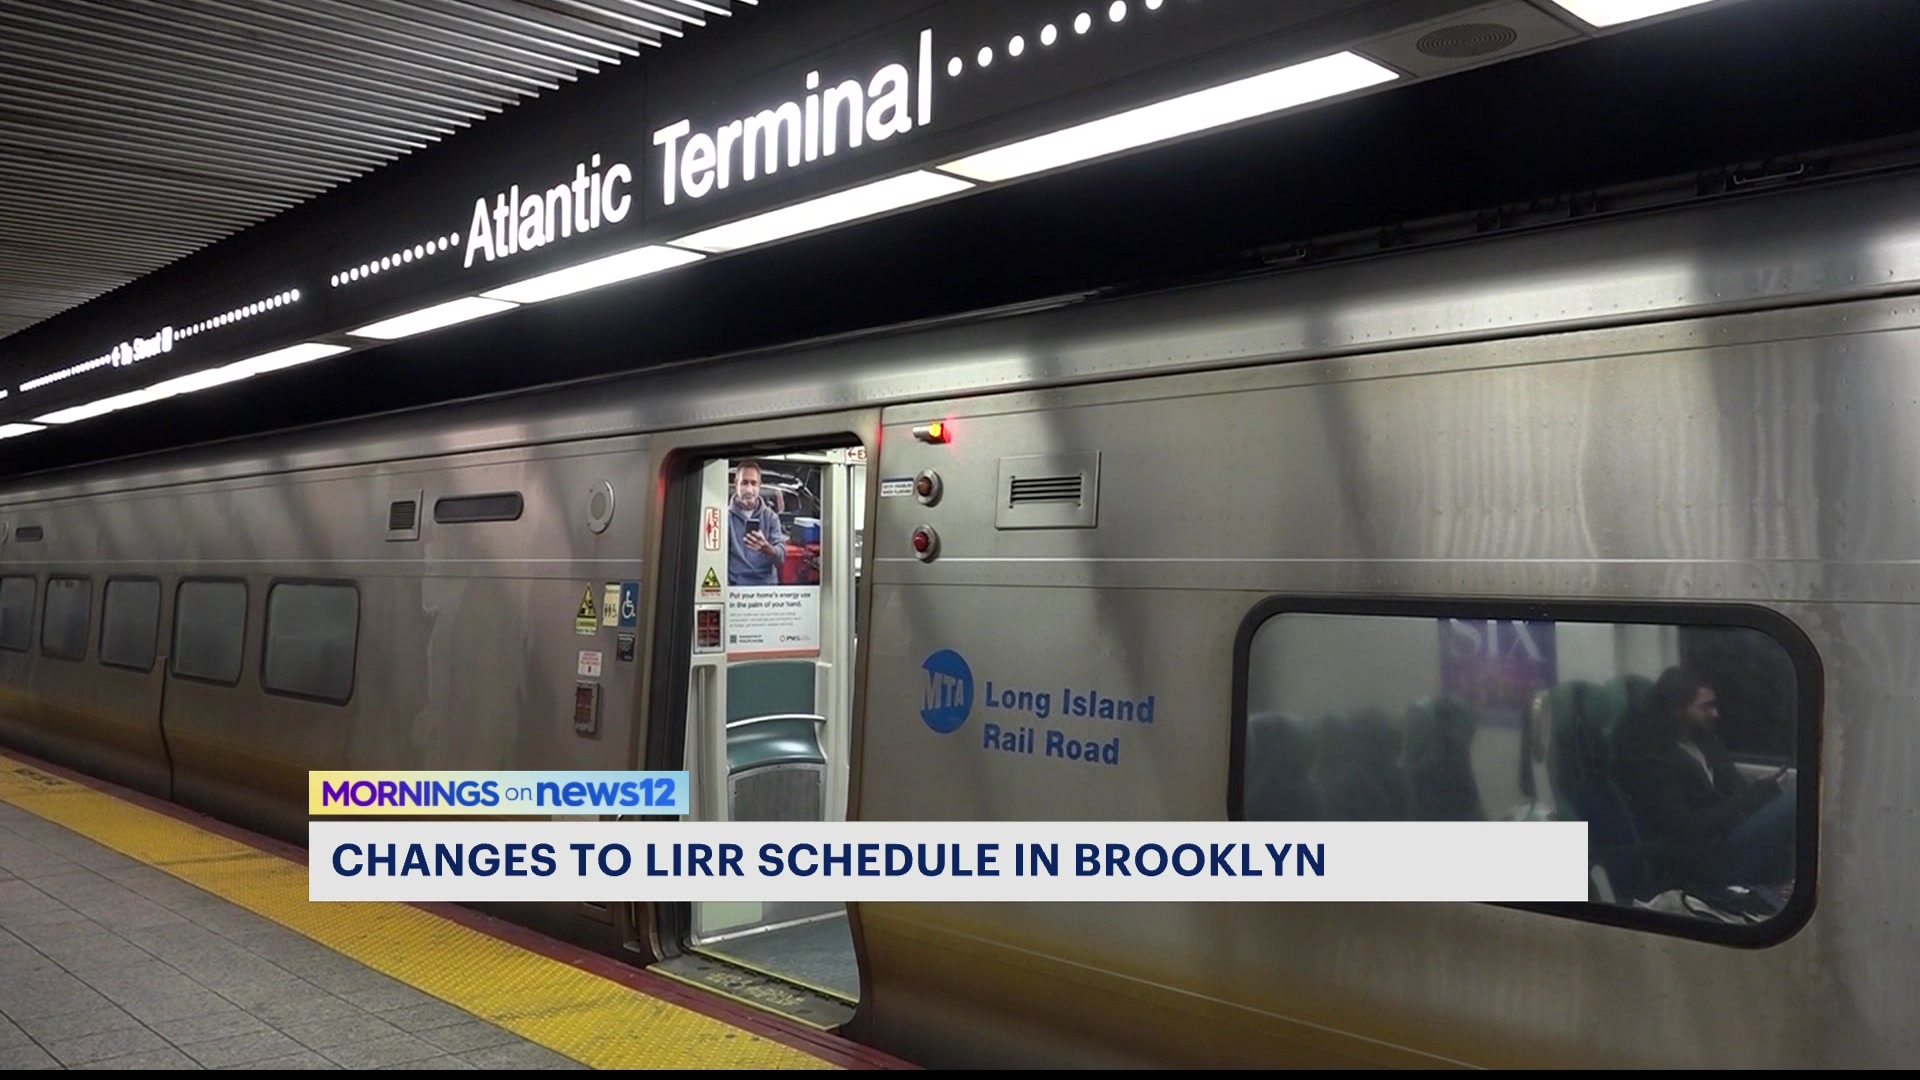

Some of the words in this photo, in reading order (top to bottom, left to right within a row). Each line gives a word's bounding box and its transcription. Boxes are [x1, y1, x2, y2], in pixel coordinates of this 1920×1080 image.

[463, 154, 632, 268] Atlantic
[653, 29, 932, 205] Terminal
[920, 667, 965, 711] MTA
[985, 682, 1050, 719] Long
[1062, 688, 1156, 724] Island
[983, 723, 1034, 754] Rail
[1046, 730, 1120, 765] Road
